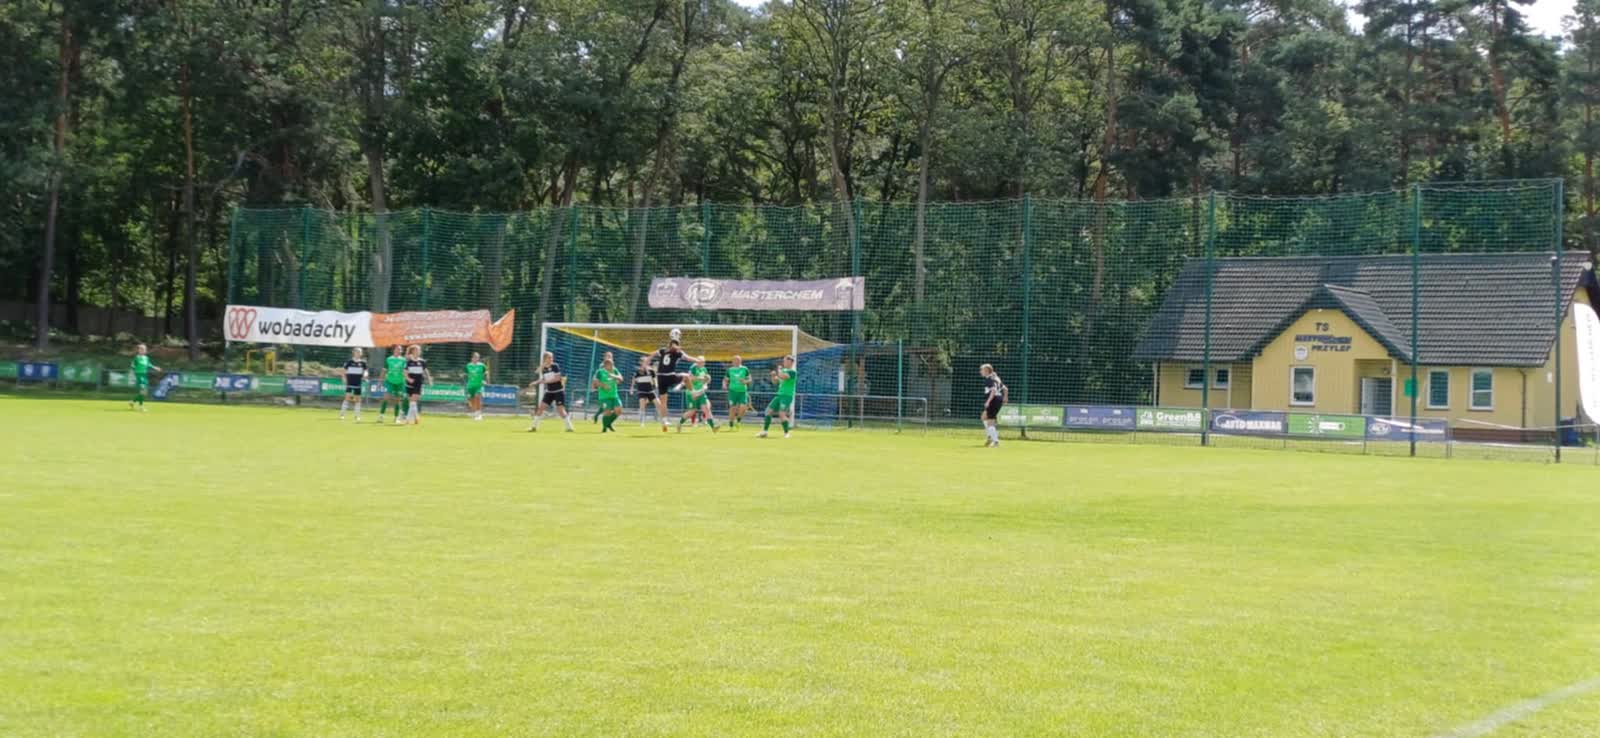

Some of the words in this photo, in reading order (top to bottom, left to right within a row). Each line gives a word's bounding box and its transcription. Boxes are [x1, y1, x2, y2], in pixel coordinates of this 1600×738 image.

[731, 289, 824, 300] MASTERCHEM
[259, 319, 356, 342] wobadachy
[1315, 322, 1330, 332] TS
[663, 354, 671, 366] 6
